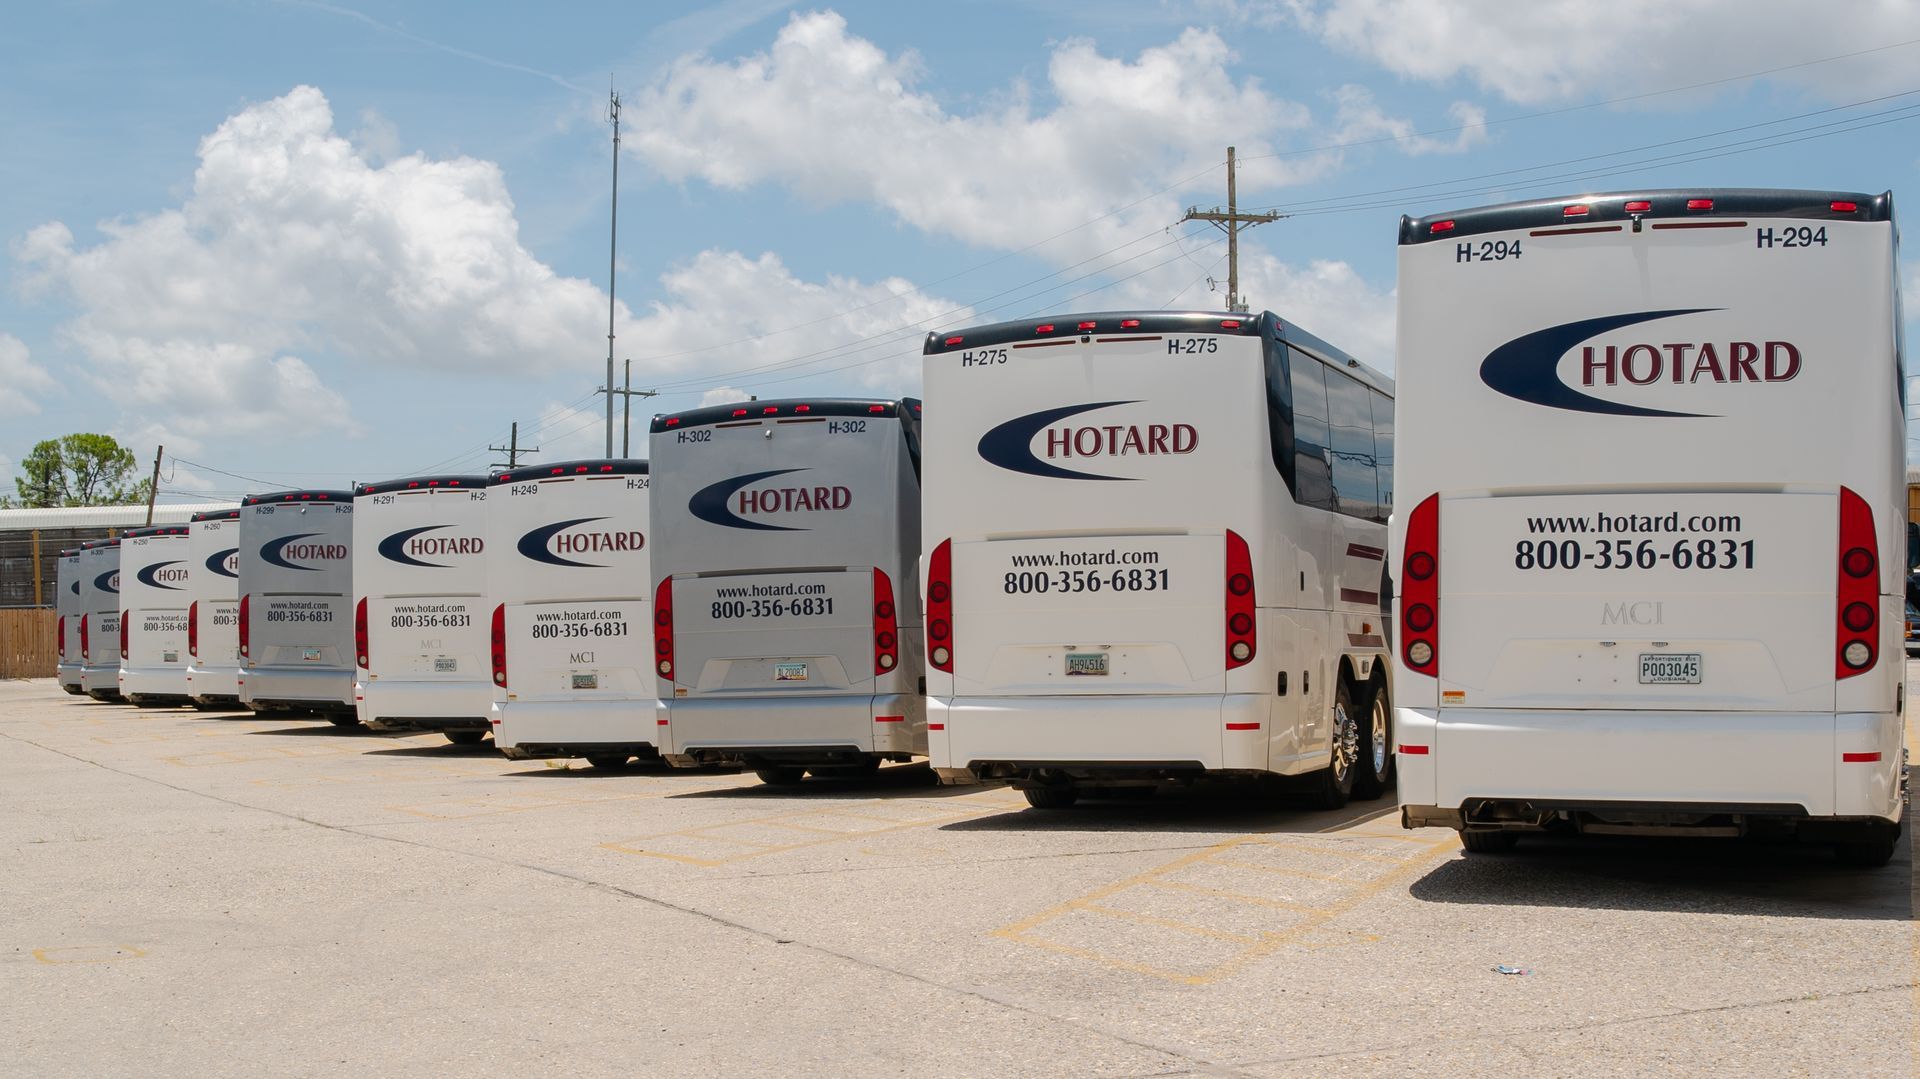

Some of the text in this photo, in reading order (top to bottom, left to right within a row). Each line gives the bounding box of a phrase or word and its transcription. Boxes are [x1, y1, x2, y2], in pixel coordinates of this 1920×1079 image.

[1756, 226, 1828, 249] H-294
[1456, 240, 1523, 263] H-294
[1167, 337, 1218, 355] H-275
[961, 348, 1008, 368] H-275
[1581, 340, 1802, 387] HOTARD
[677, 429, 712, 444] H-302
[828, 420, 867, 435] H-302
[1045, 422, 1200, 460] HOTARD
[511, 484, 538, 496] H-249
[373, 495, 395, 505] H-291
[738, 485, 853, 515] HOTARD
[256, 506, 275, 515] H-299
[1526, 511, 1742, 534] www.hotard.com
[410, 537, 485, 556] HOTARD
[556, 530, 646, 554] HOTARD
[286, 544, 348, 561] HOTARD
[1011, 548, 1160, 568] www.hotard.com
[1514, 539, 1755, 570] 800-356-6831
[716, 582, 826, 599] www.hotard.com
[1004, 568, 1169, 595] 800-356-6831
[270, 601, 329, 610] www.hotard.com
[394, 603, 466, 614] www.hotard.com
[711, 597, 834, 619] 800-356-6831
[1599, 600, 1665, 626] MCI
[267, 610, 333, 622] 800-356-6831
[391, 614, 471, 628] 800-356-6831
[536, 609, 622, 622] www.hotard.com
[532, 621, 628, 639] 800-356-6831
[569, 651, 595, 664] MCI
[1642, 662, 1698, 677] P003045
